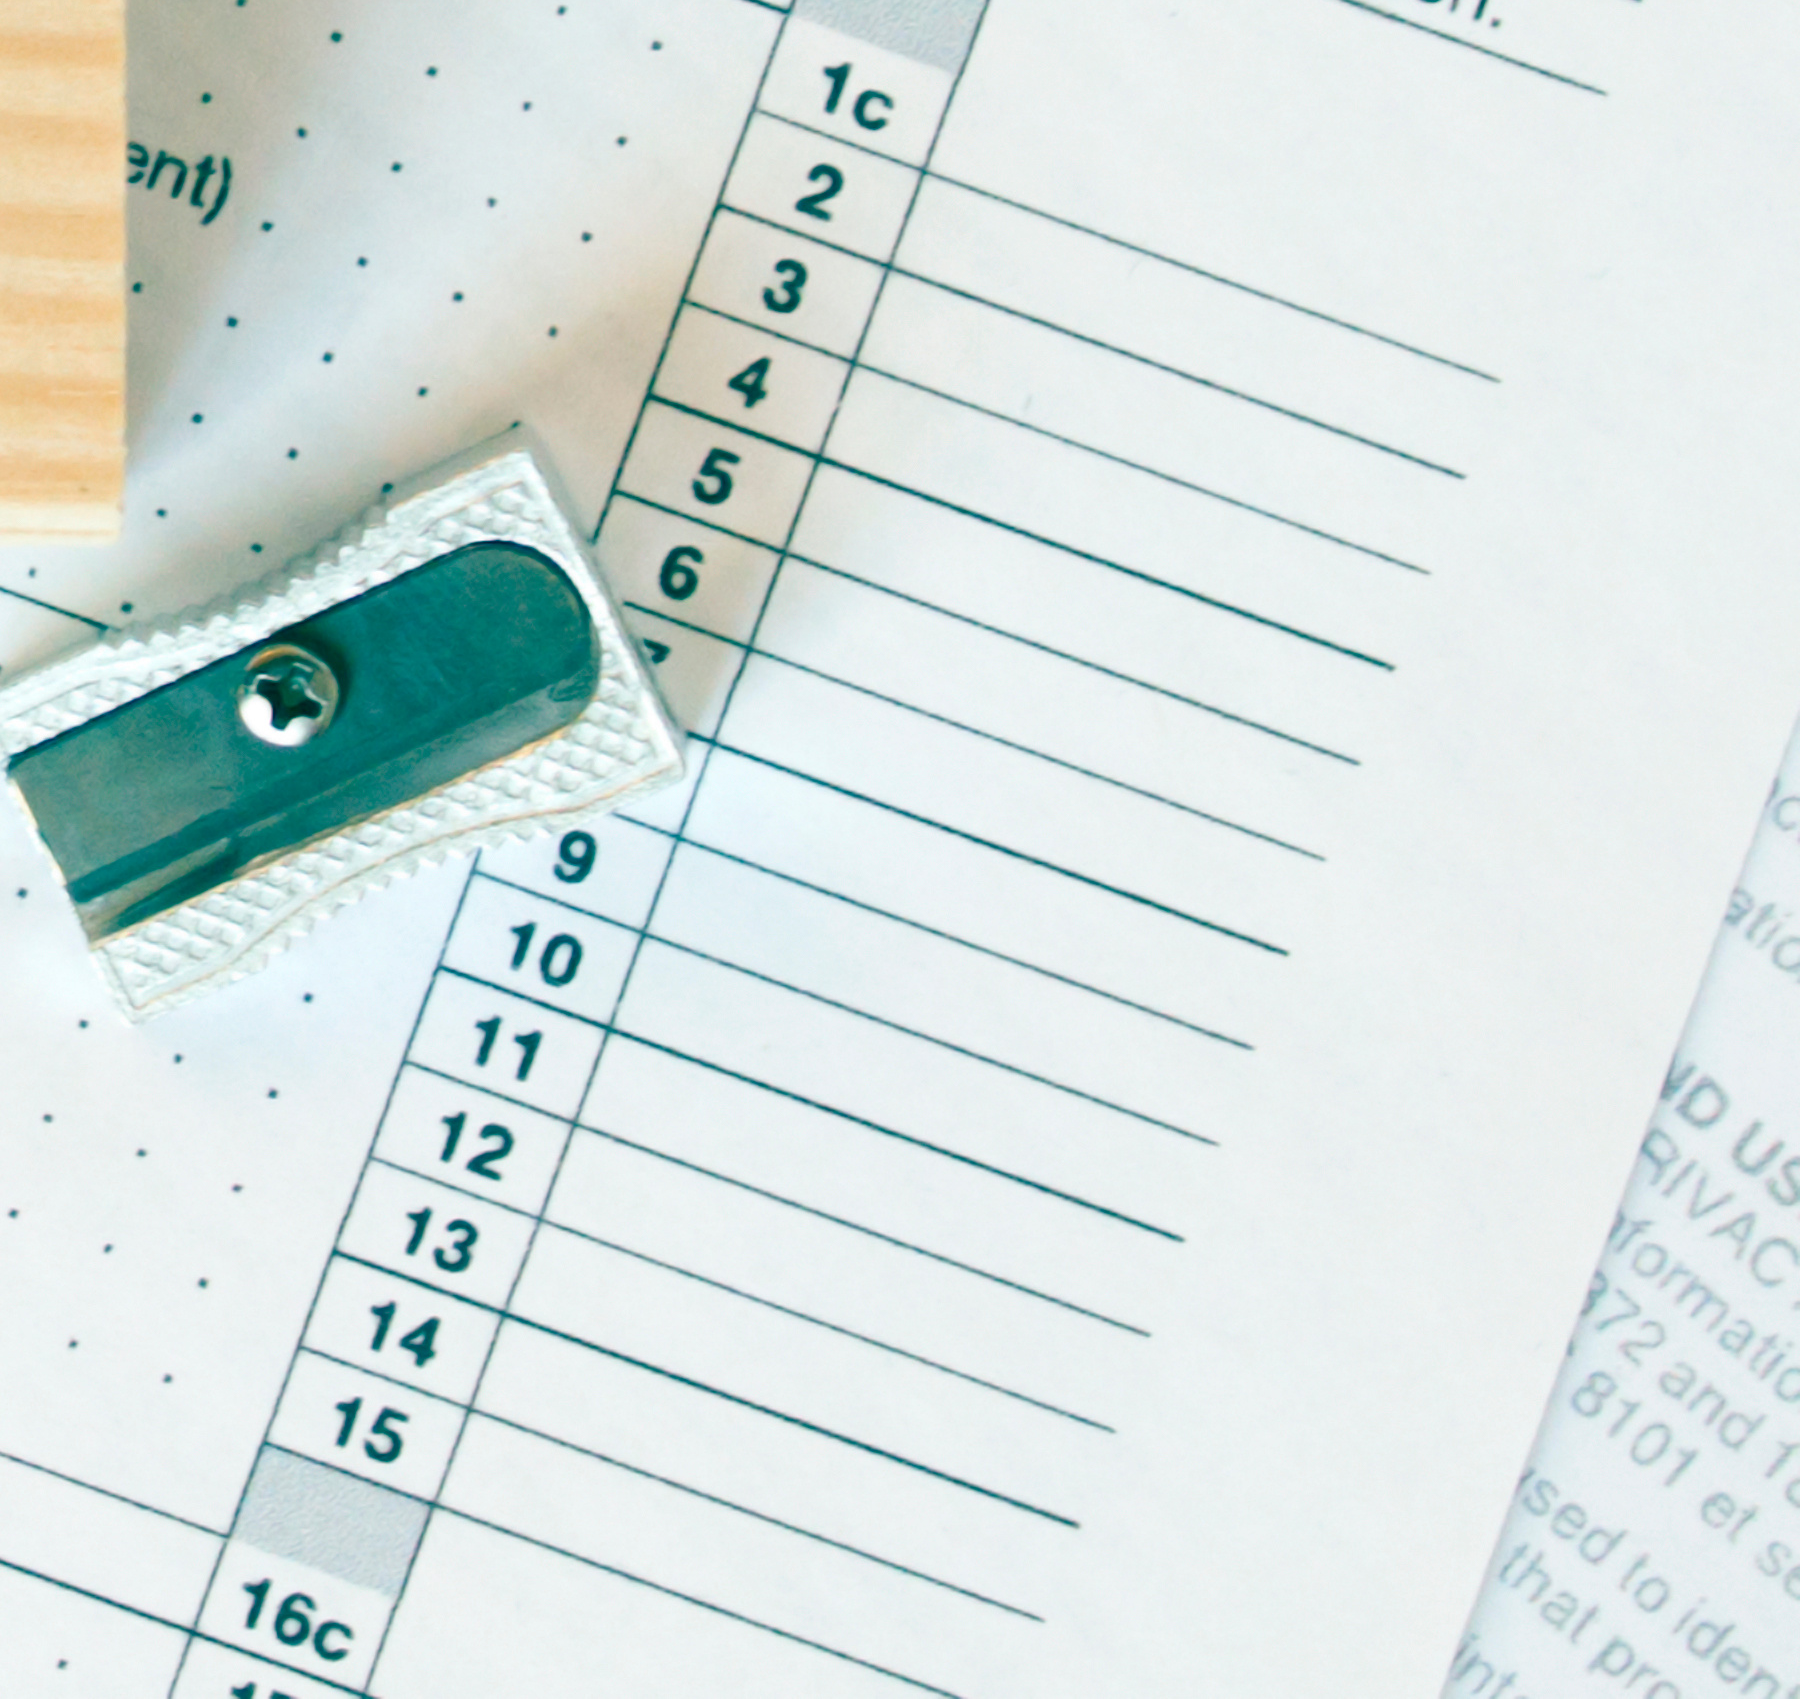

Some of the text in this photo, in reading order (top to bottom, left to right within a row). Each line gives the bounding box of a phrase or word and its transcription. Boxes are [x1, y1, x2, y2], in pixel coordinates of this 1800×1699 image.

[821, 61, 896, 133] 1c
[690, 446, 743, 507] 5
[508, 920, 586, 990] 10
[241, 1577, 355, 1664] 16c
